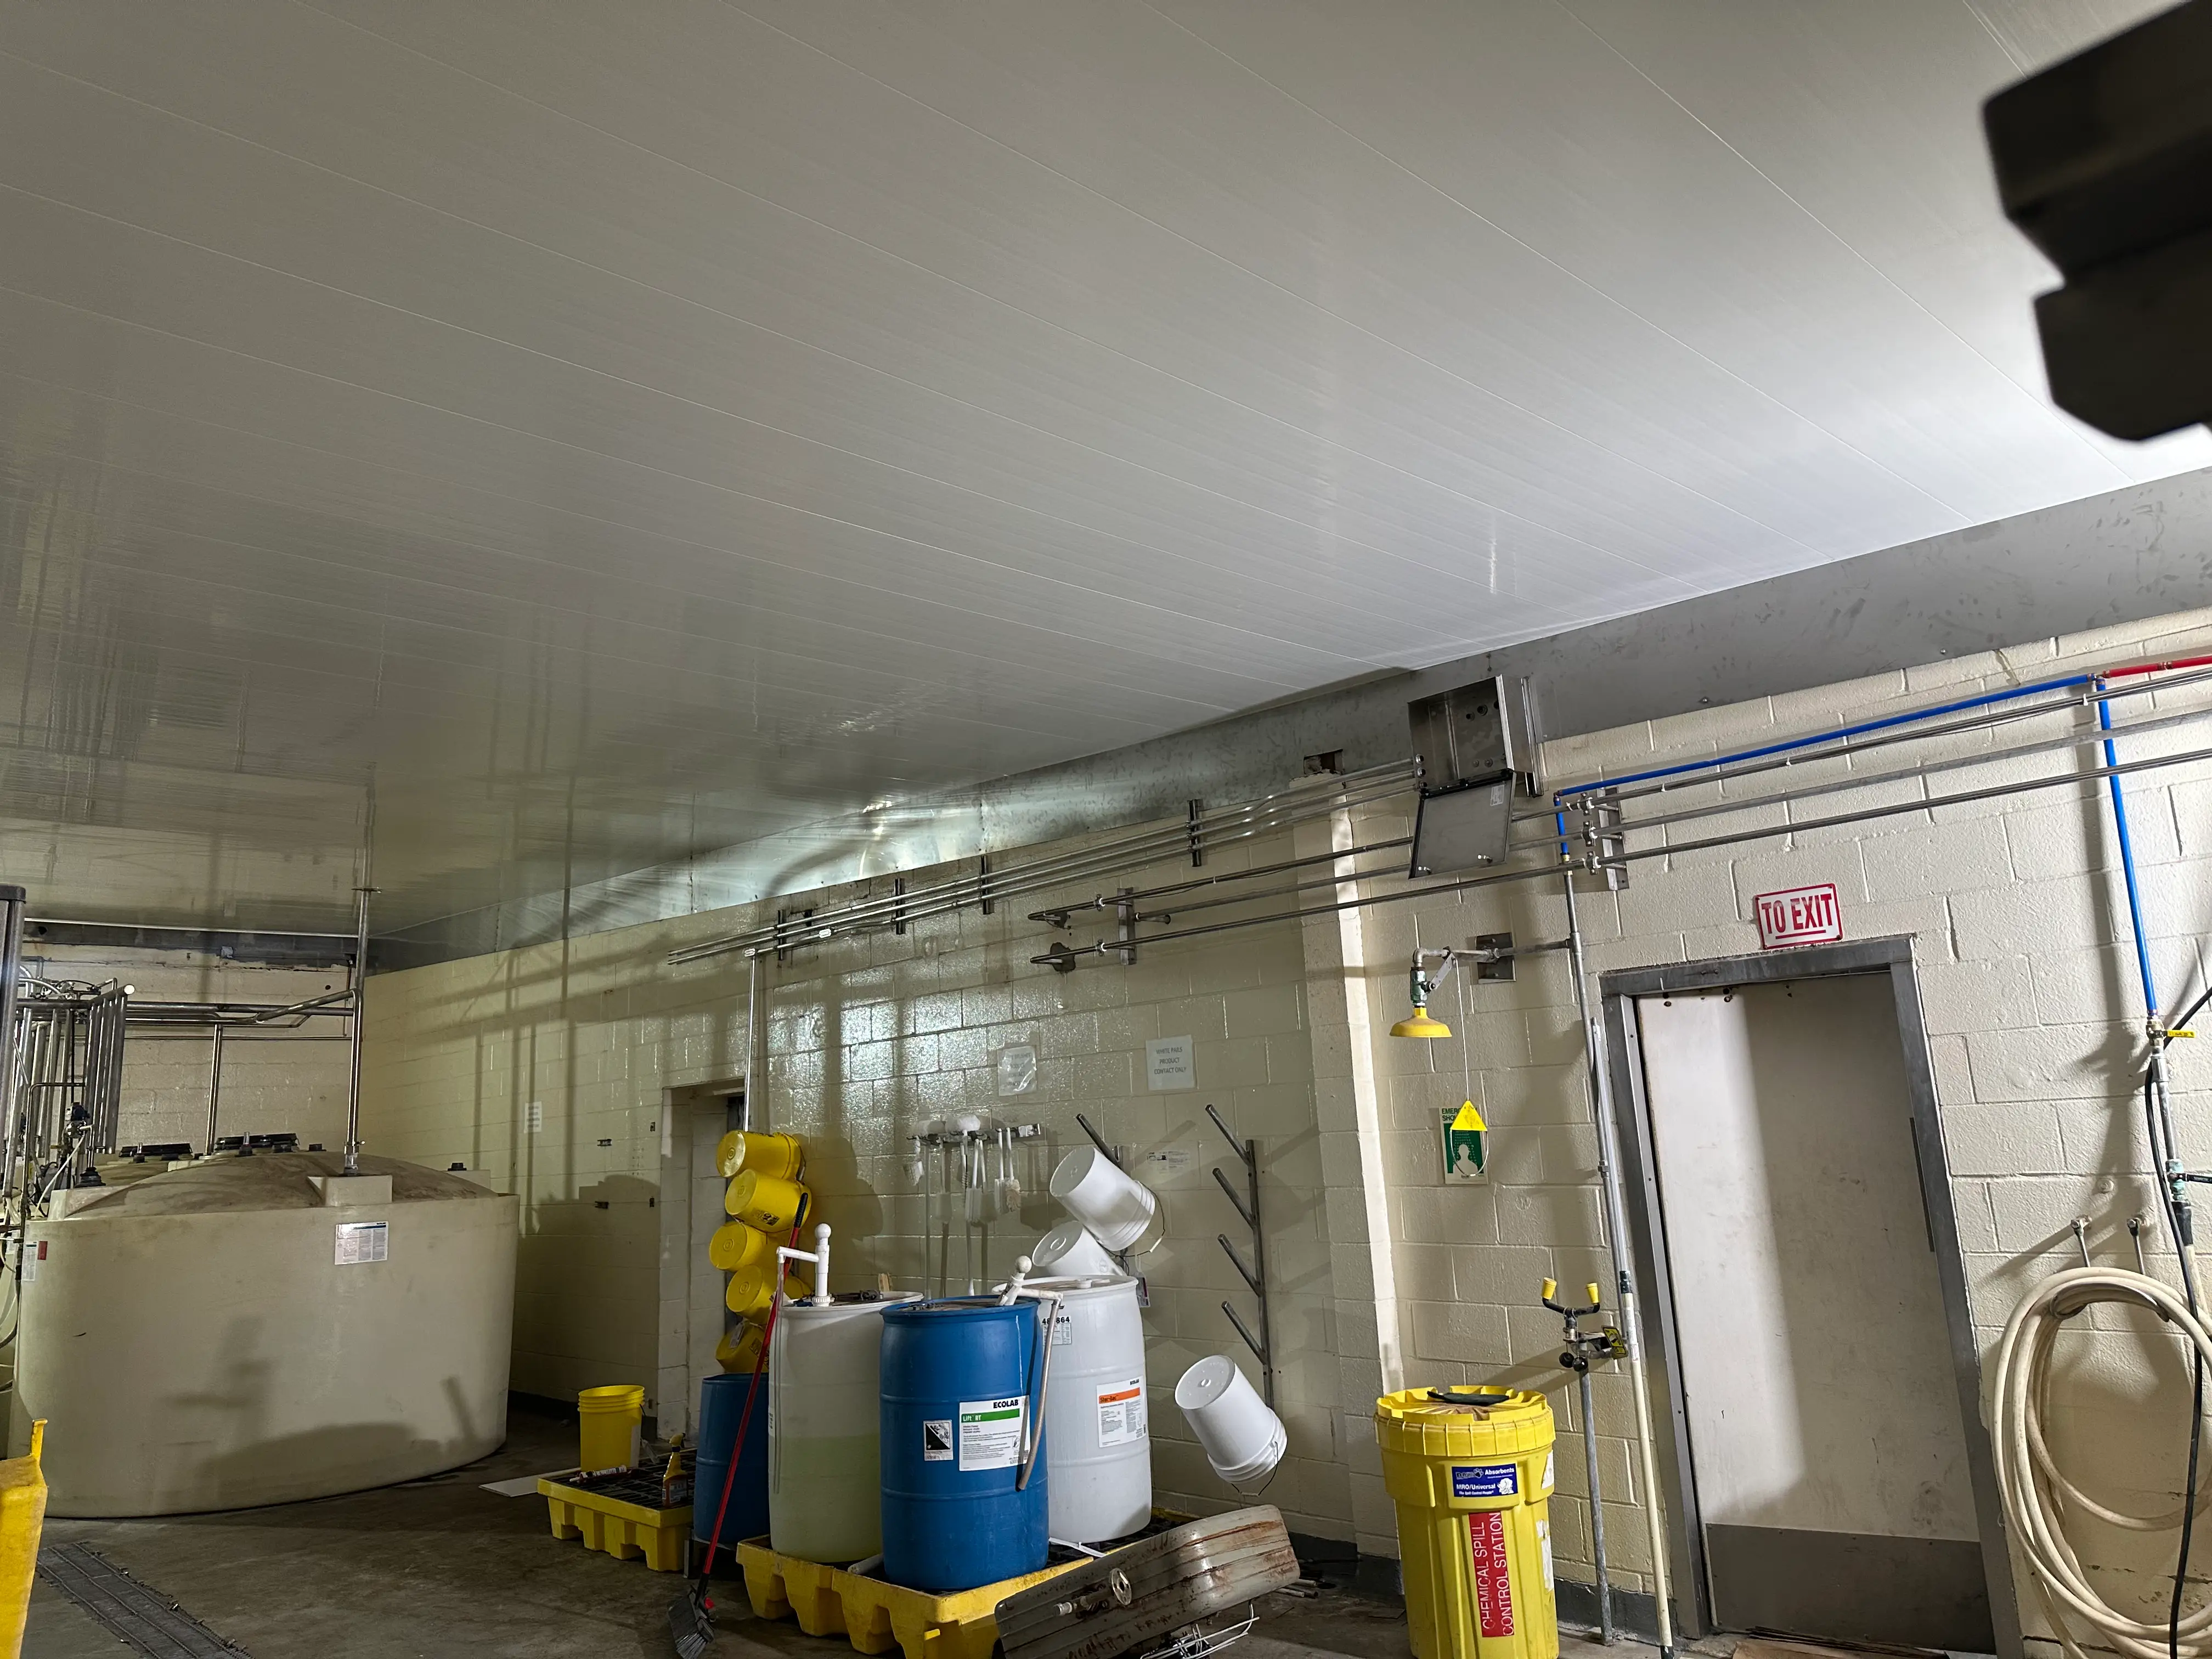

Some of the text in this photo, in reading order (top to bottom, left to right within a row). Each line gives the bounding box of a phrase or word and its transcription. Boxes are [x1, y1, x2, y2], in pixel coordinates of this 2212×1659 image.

[1761, 893, 1833, 934] TO EXIT
[993, 1399, 1019, 1409] ECOLAB
[1485, 1467, 1515, 1475] Absorbents
[1471, 1522, 1496, 1629] CHEMICAL SPILL
[1488, 1512, 1514, 1635] CONTROL STATION
